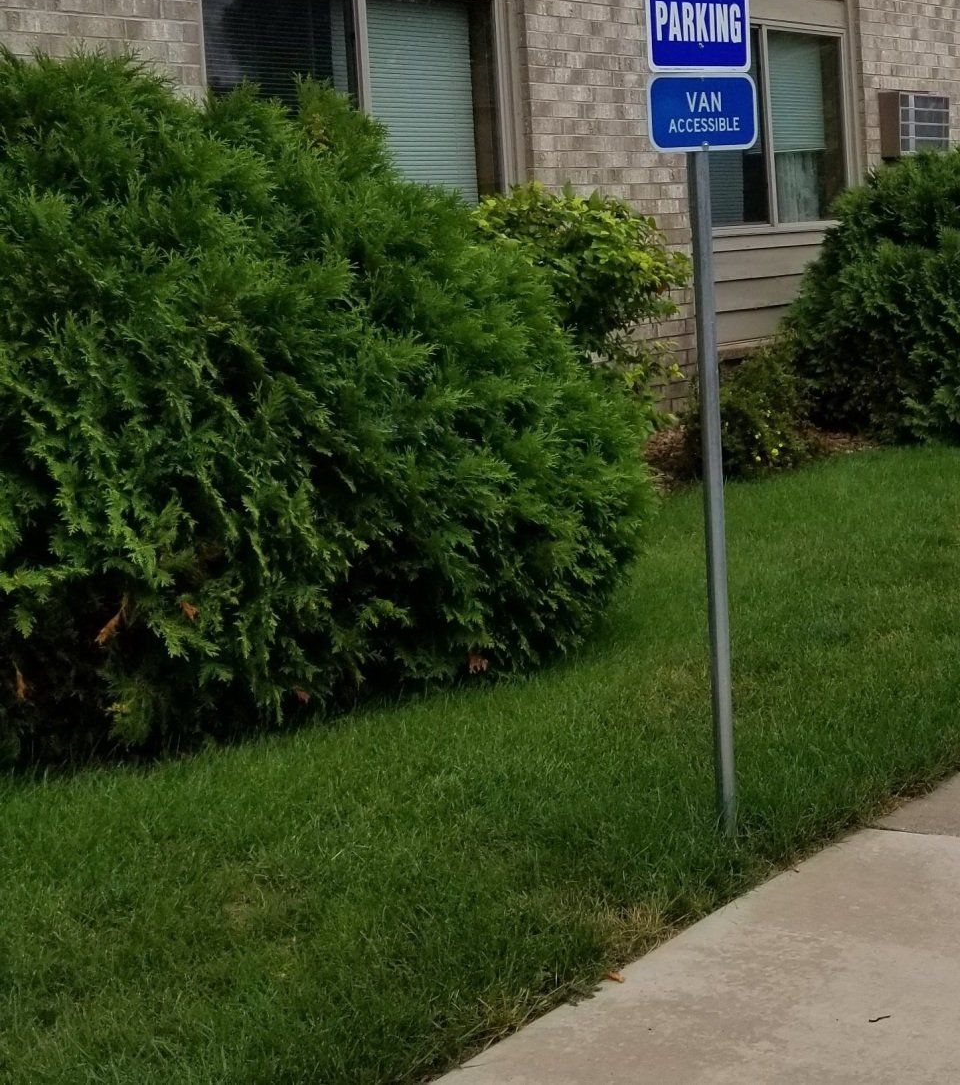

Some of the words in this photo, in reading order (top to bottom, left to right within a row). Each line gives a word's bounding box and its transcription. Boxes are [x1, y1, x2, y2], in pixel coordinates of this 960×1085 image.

[655, 0, 742, 43] PARKING
[686, 91, 722, 113] VAN
[669, 116, 740, 133] ACCESSIBLE
